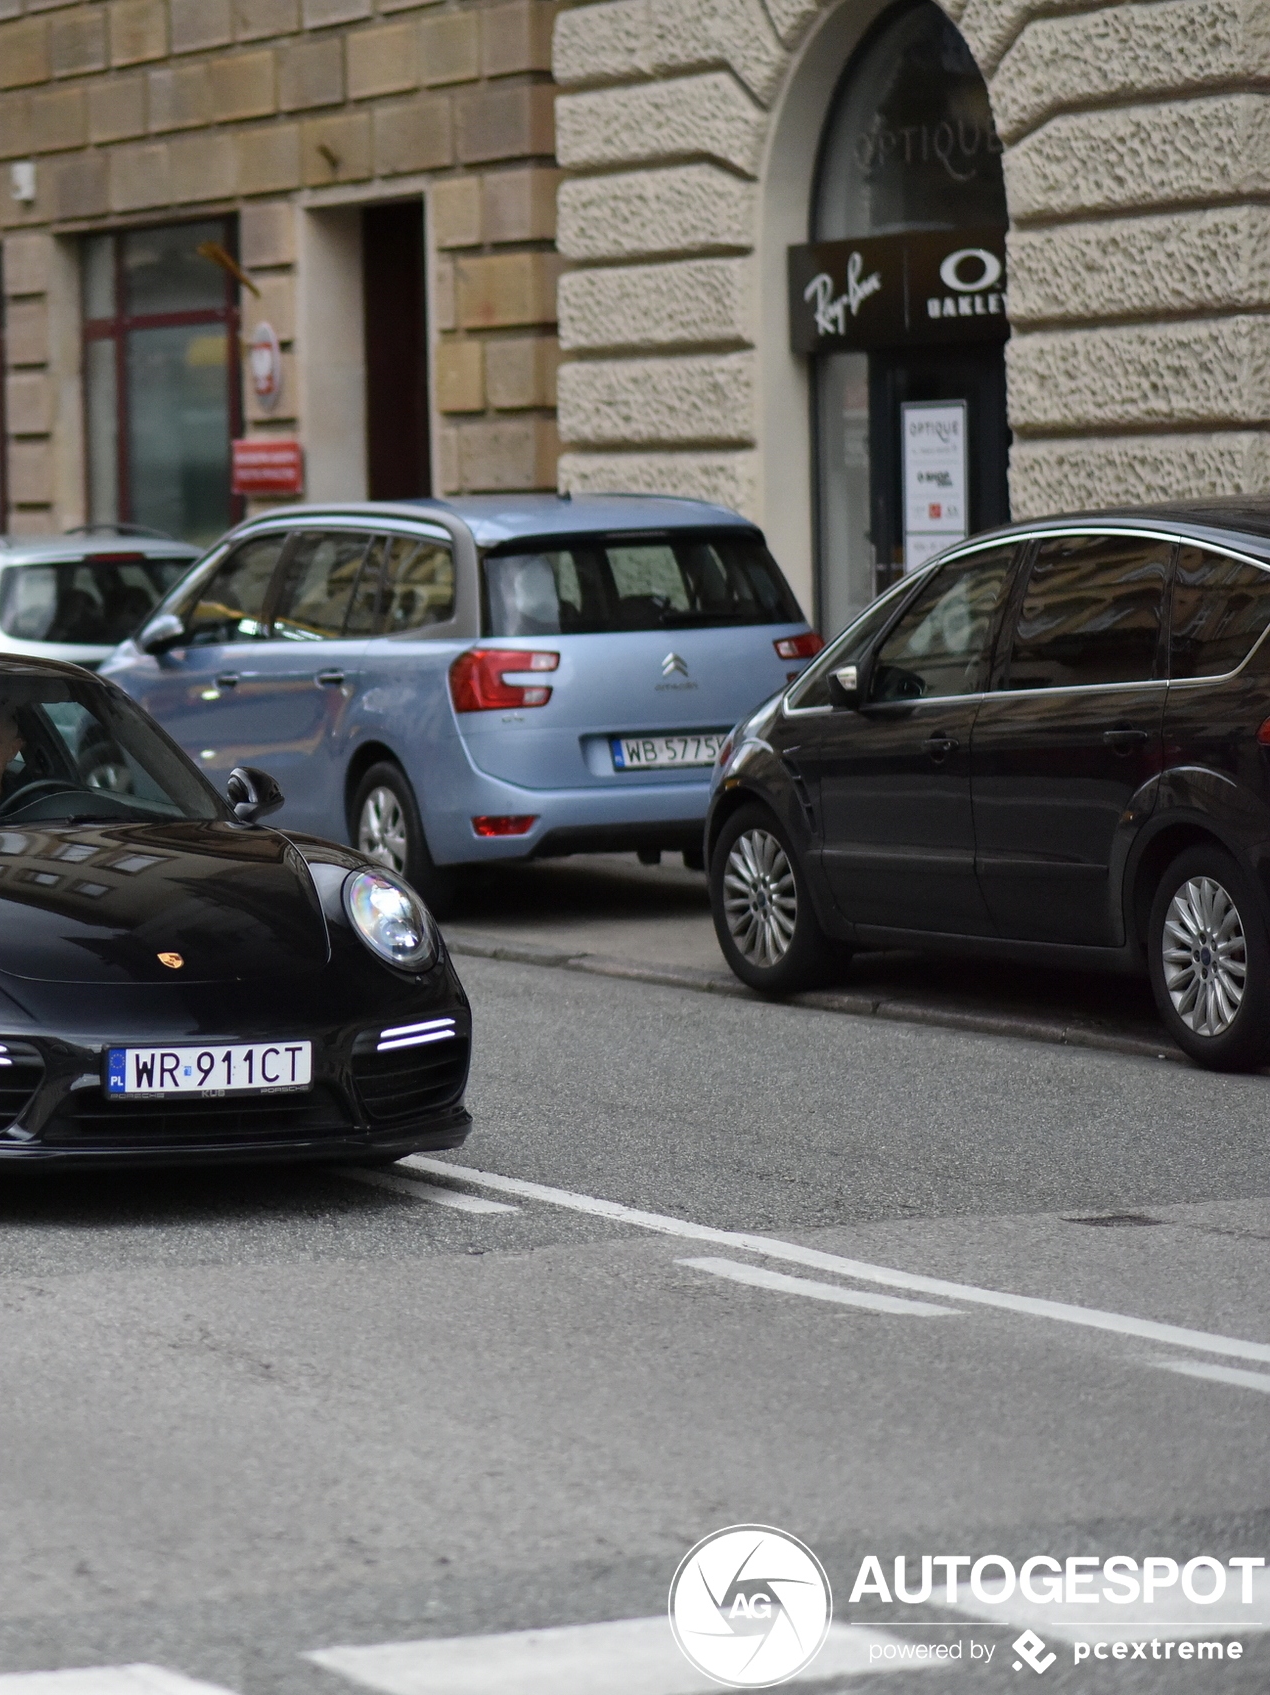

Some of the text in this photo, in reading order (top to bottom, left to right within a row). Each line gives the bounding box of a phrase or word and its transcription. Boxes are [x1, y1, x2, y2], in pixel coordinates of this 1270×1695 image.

[625, 738, 658, 763] WB
[110, 1046, 303, 1088] PL WR 911CT
[260, 1085, 309, 1094] PORSCHE
